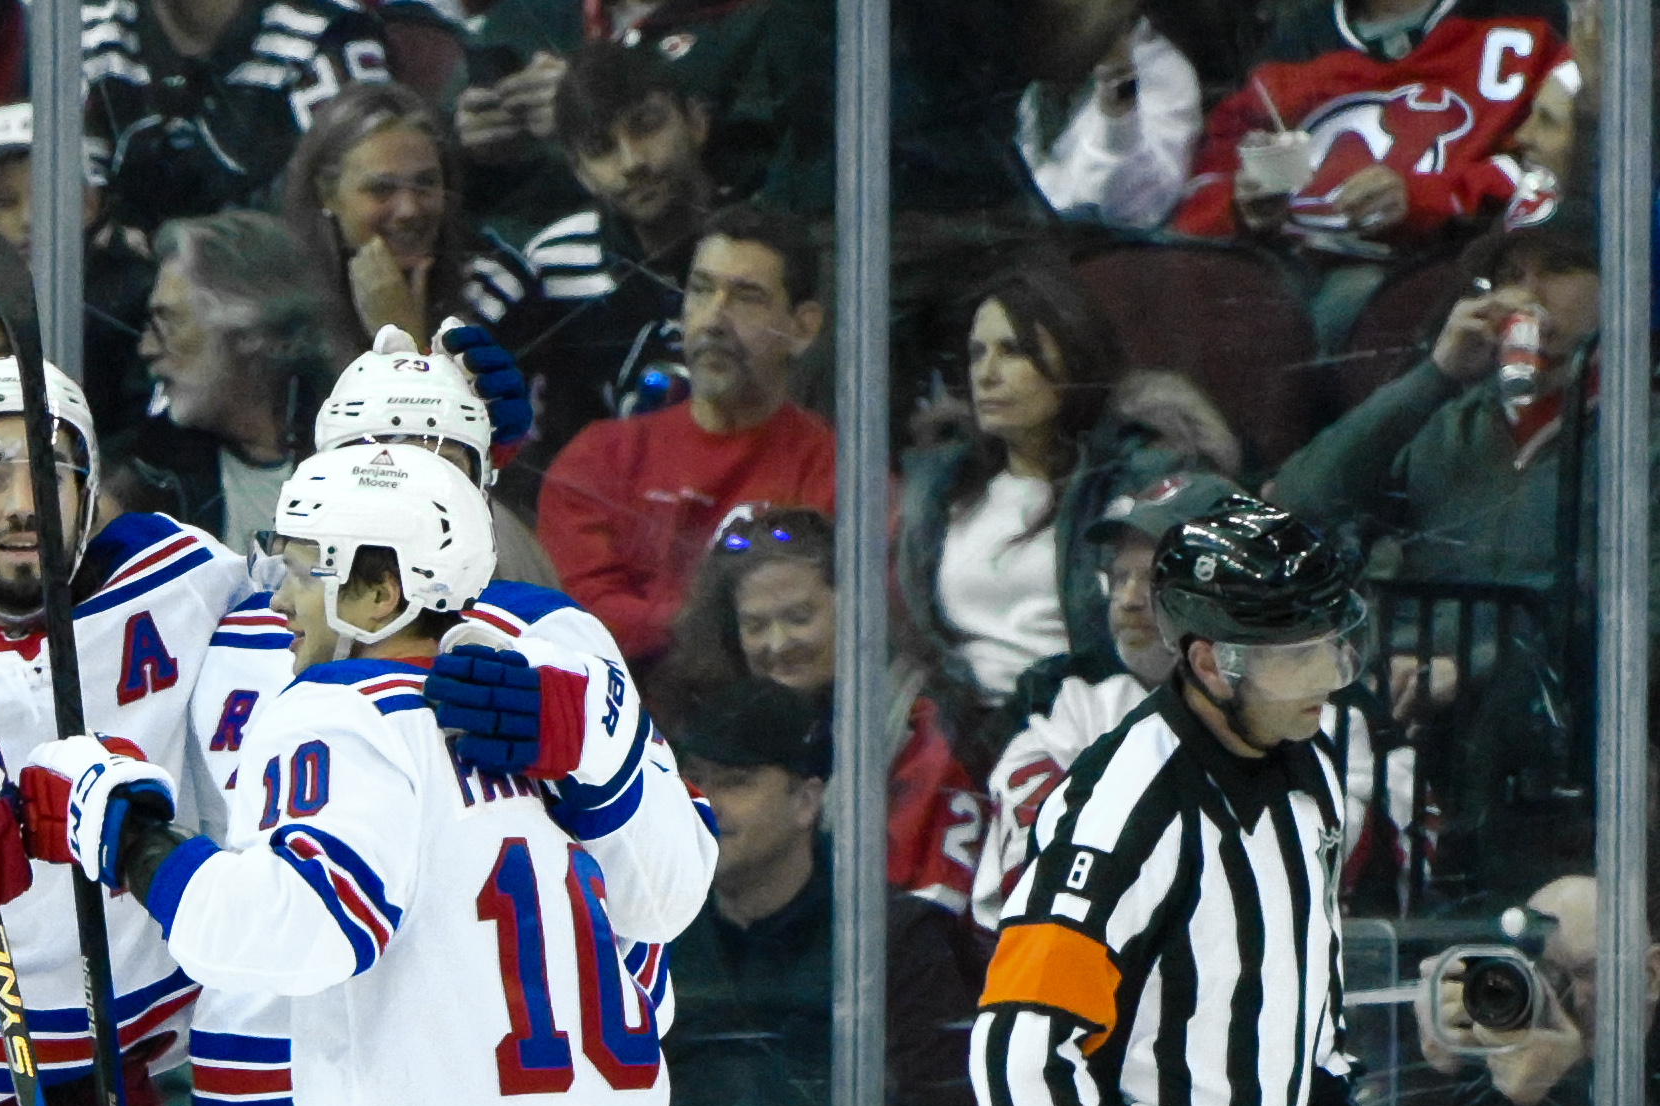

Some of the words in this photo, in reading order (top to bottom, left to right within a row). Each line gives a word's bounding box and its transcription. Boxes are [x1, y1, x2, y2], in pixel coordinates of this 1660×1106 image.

[1478, 26, 1534, 102] C
[351, 465, 409, 480] Benjamin
[358, 478, 399, 490] Moore
[117, 611, 179, 706] A
[258, 739, 331, 831] 10
[1067, 851, 1094, 890] 8
[476, 836, 662, 1097] 10
